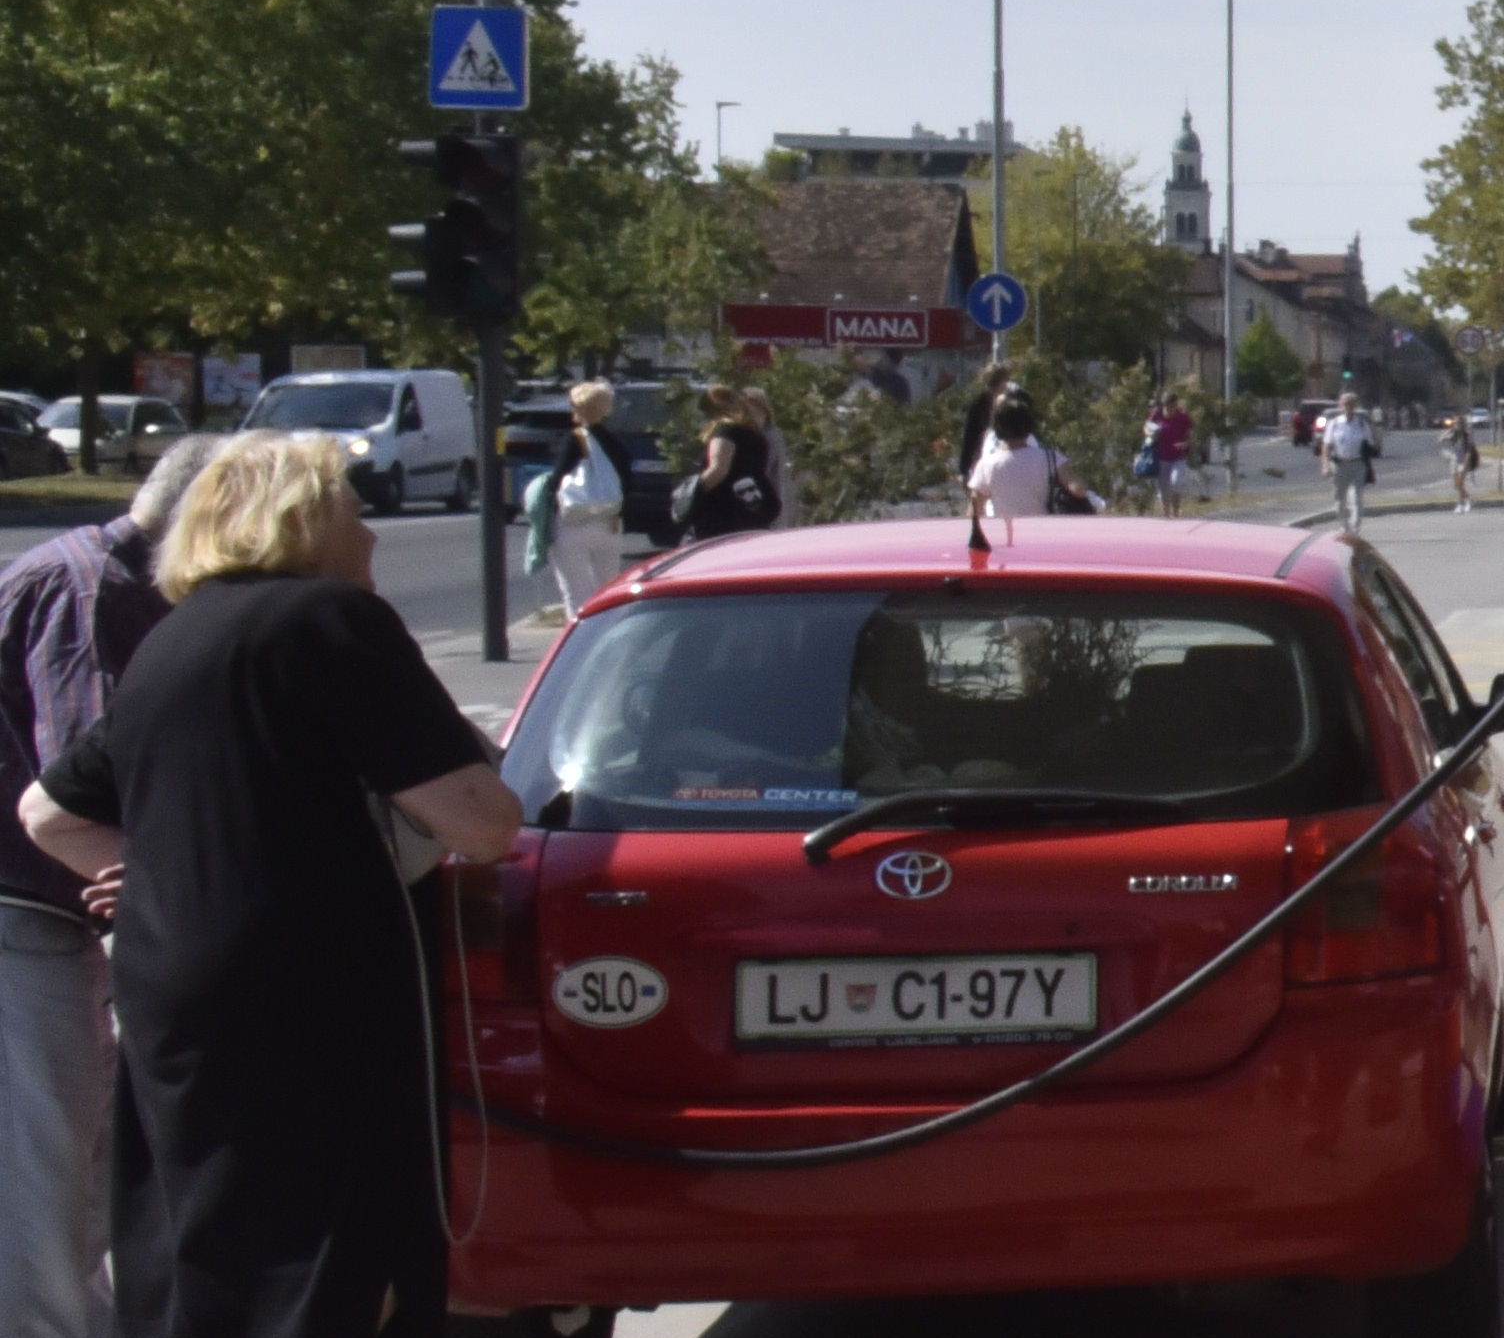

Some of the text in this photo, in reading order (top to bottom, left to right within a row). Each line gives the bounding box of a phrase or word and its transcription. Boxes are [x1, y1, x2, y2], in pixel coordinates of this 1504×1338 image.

[835, 317, 919, 338] MANA
[701, 787, 858, 803] TOYOTA CENTER
[582, 971, 637, 1013] SLO
[767, 967, 1066, 1025] LJ C1-97Y
